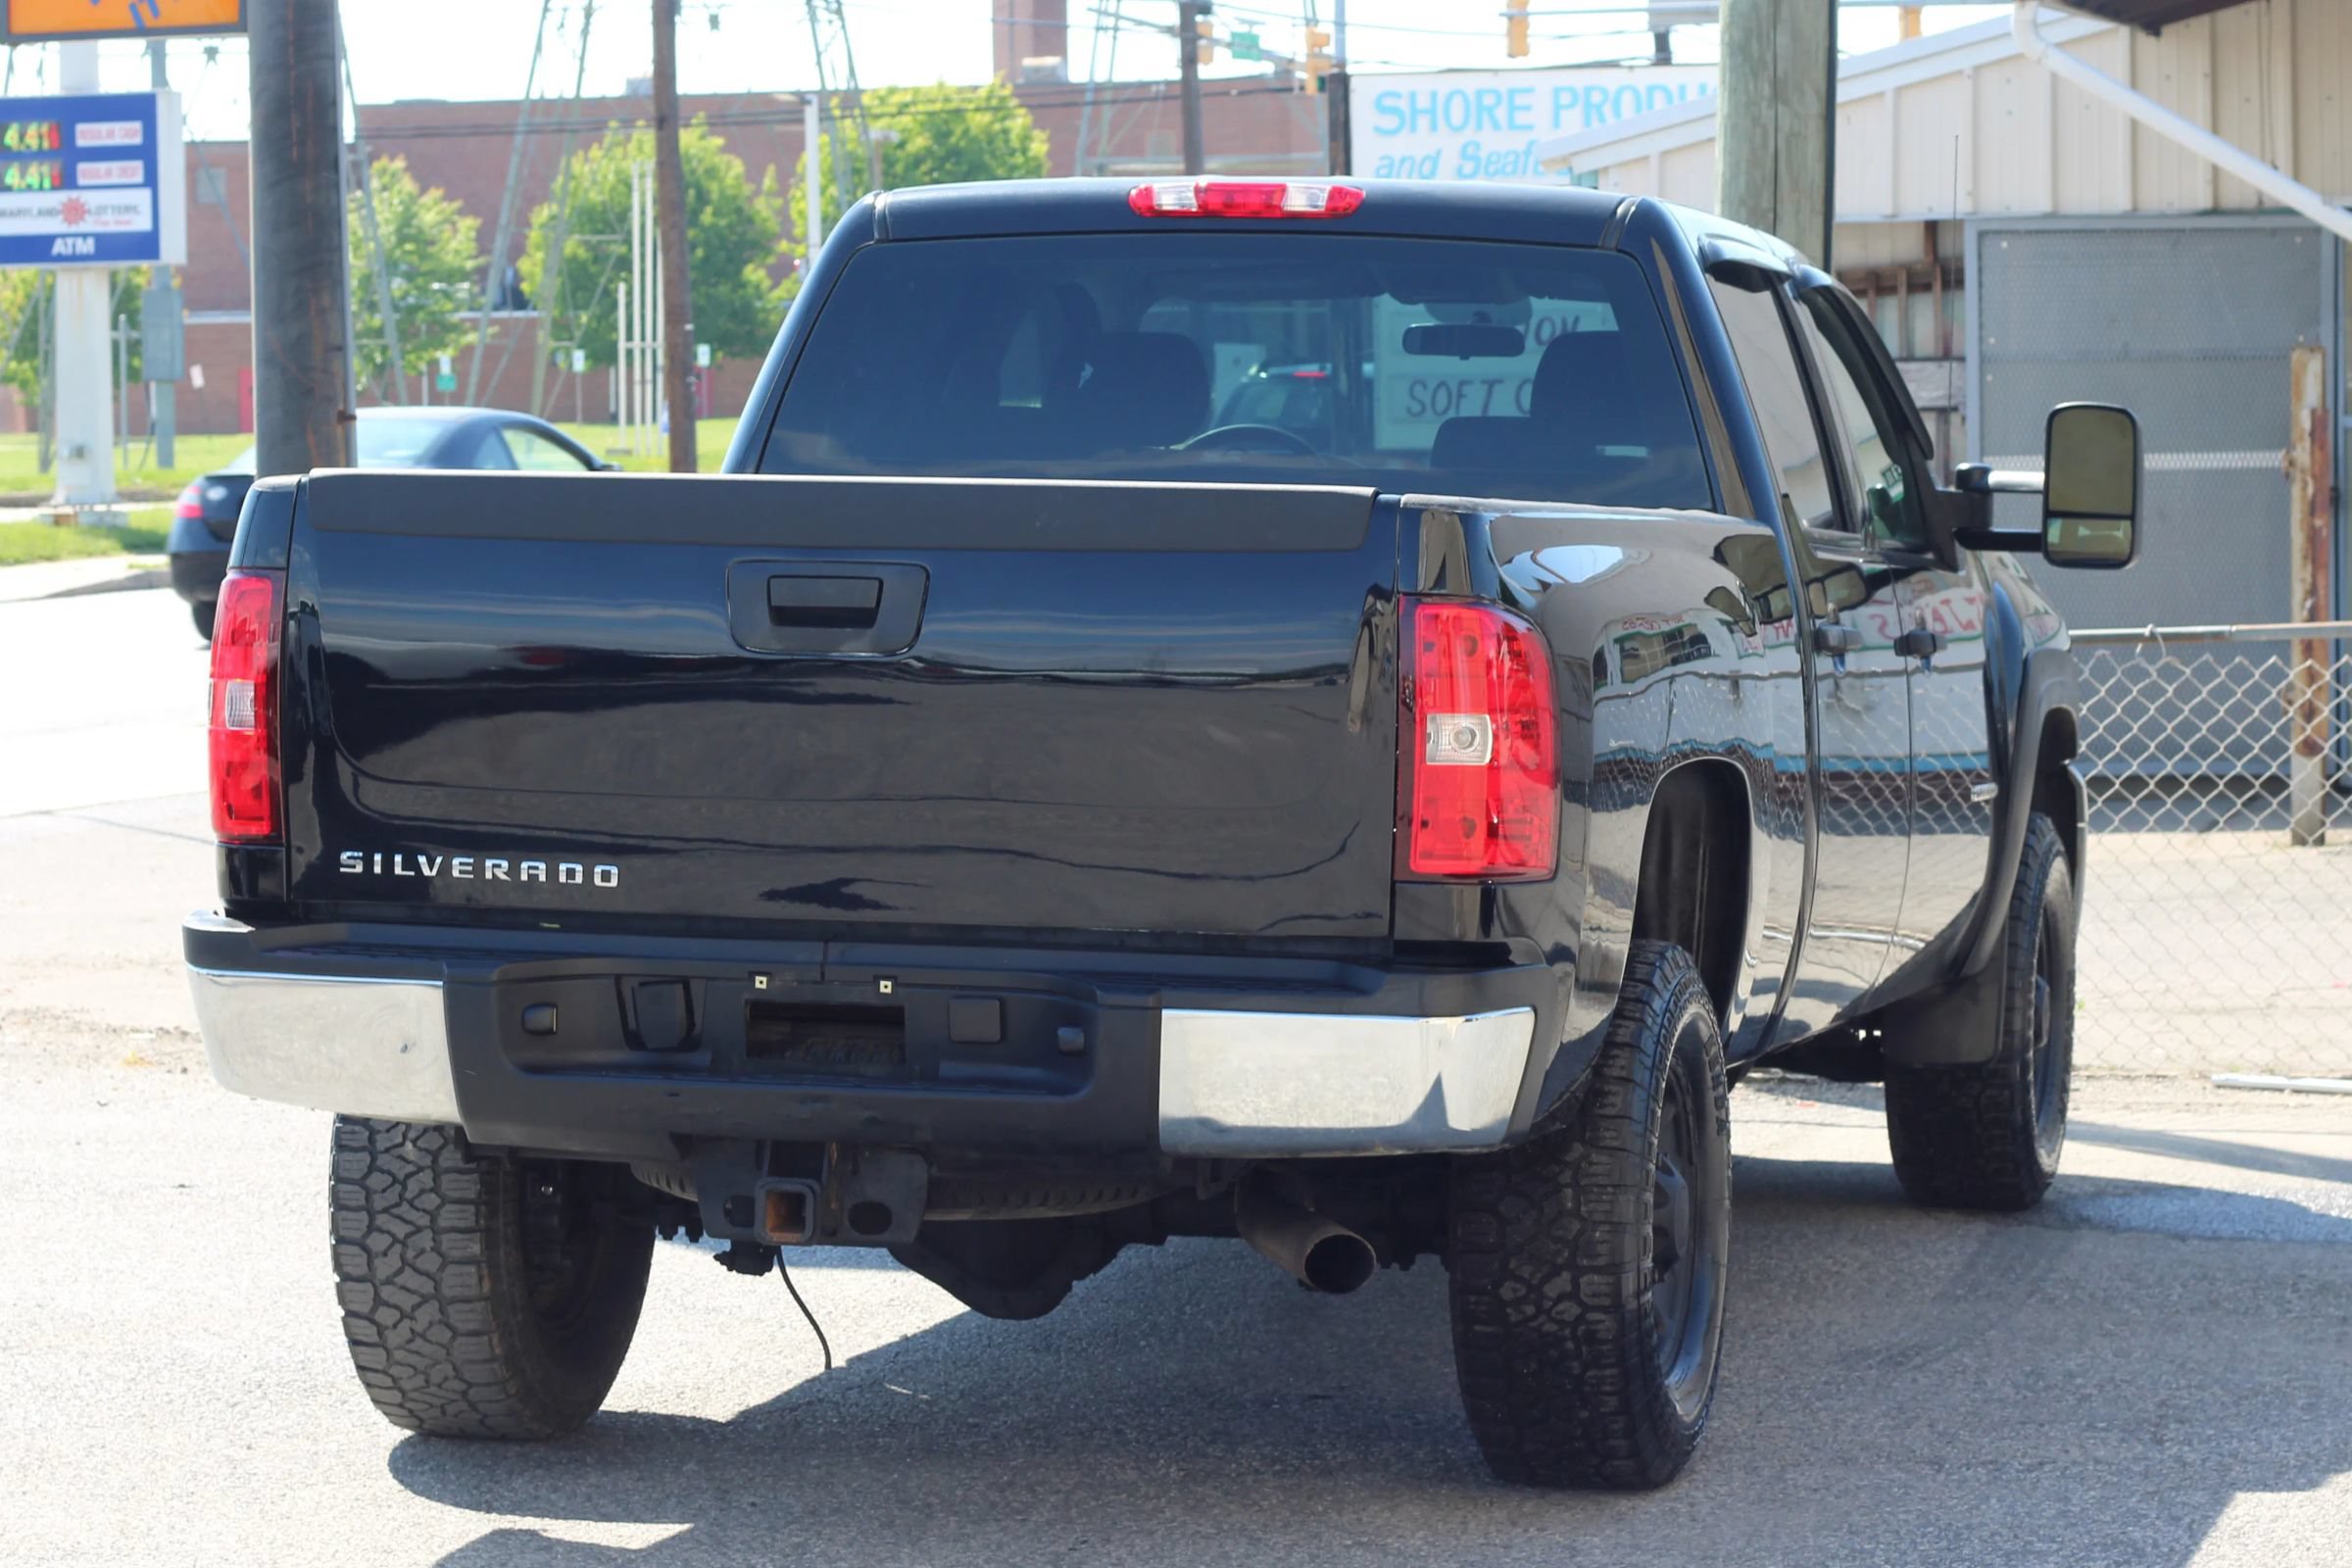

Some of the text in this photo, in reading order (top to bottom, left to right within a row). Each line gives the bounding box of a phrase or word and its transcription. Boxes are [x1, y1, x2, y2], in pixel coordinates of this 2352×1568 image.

[1373, 86, 1536, 135] SHORE
[1374, 140, 1570, 180] and Seaf
[51, 236, 95, 256] ATM
[1405, 378, 1503, 416] SOFT
[339, 851, 619, 888] SILVERADO
